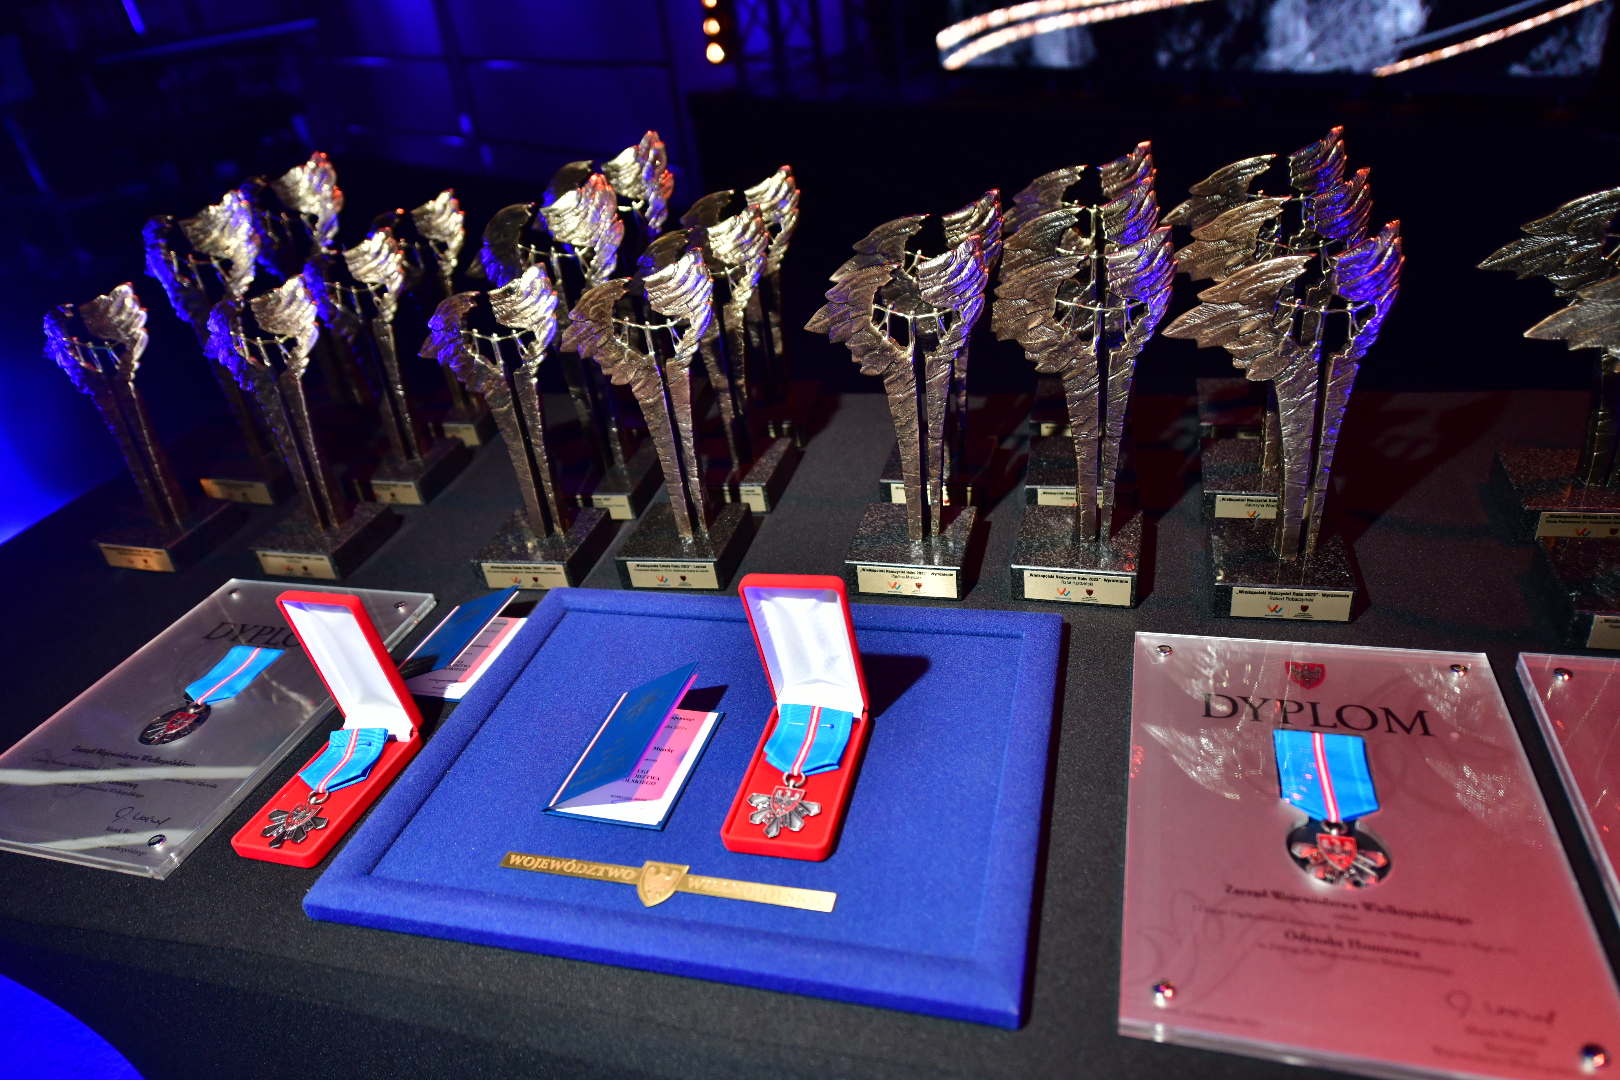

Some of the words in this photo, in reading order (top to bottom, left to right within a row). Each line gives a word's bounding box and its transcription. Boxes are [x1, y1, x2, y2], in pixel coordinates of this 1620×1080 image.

[202, 622, 301, 648] DYPLO
[1201, 693, 1435, 737] DYPLOM
[509, 853, 637, 881] WOJEWÓDZTWO
